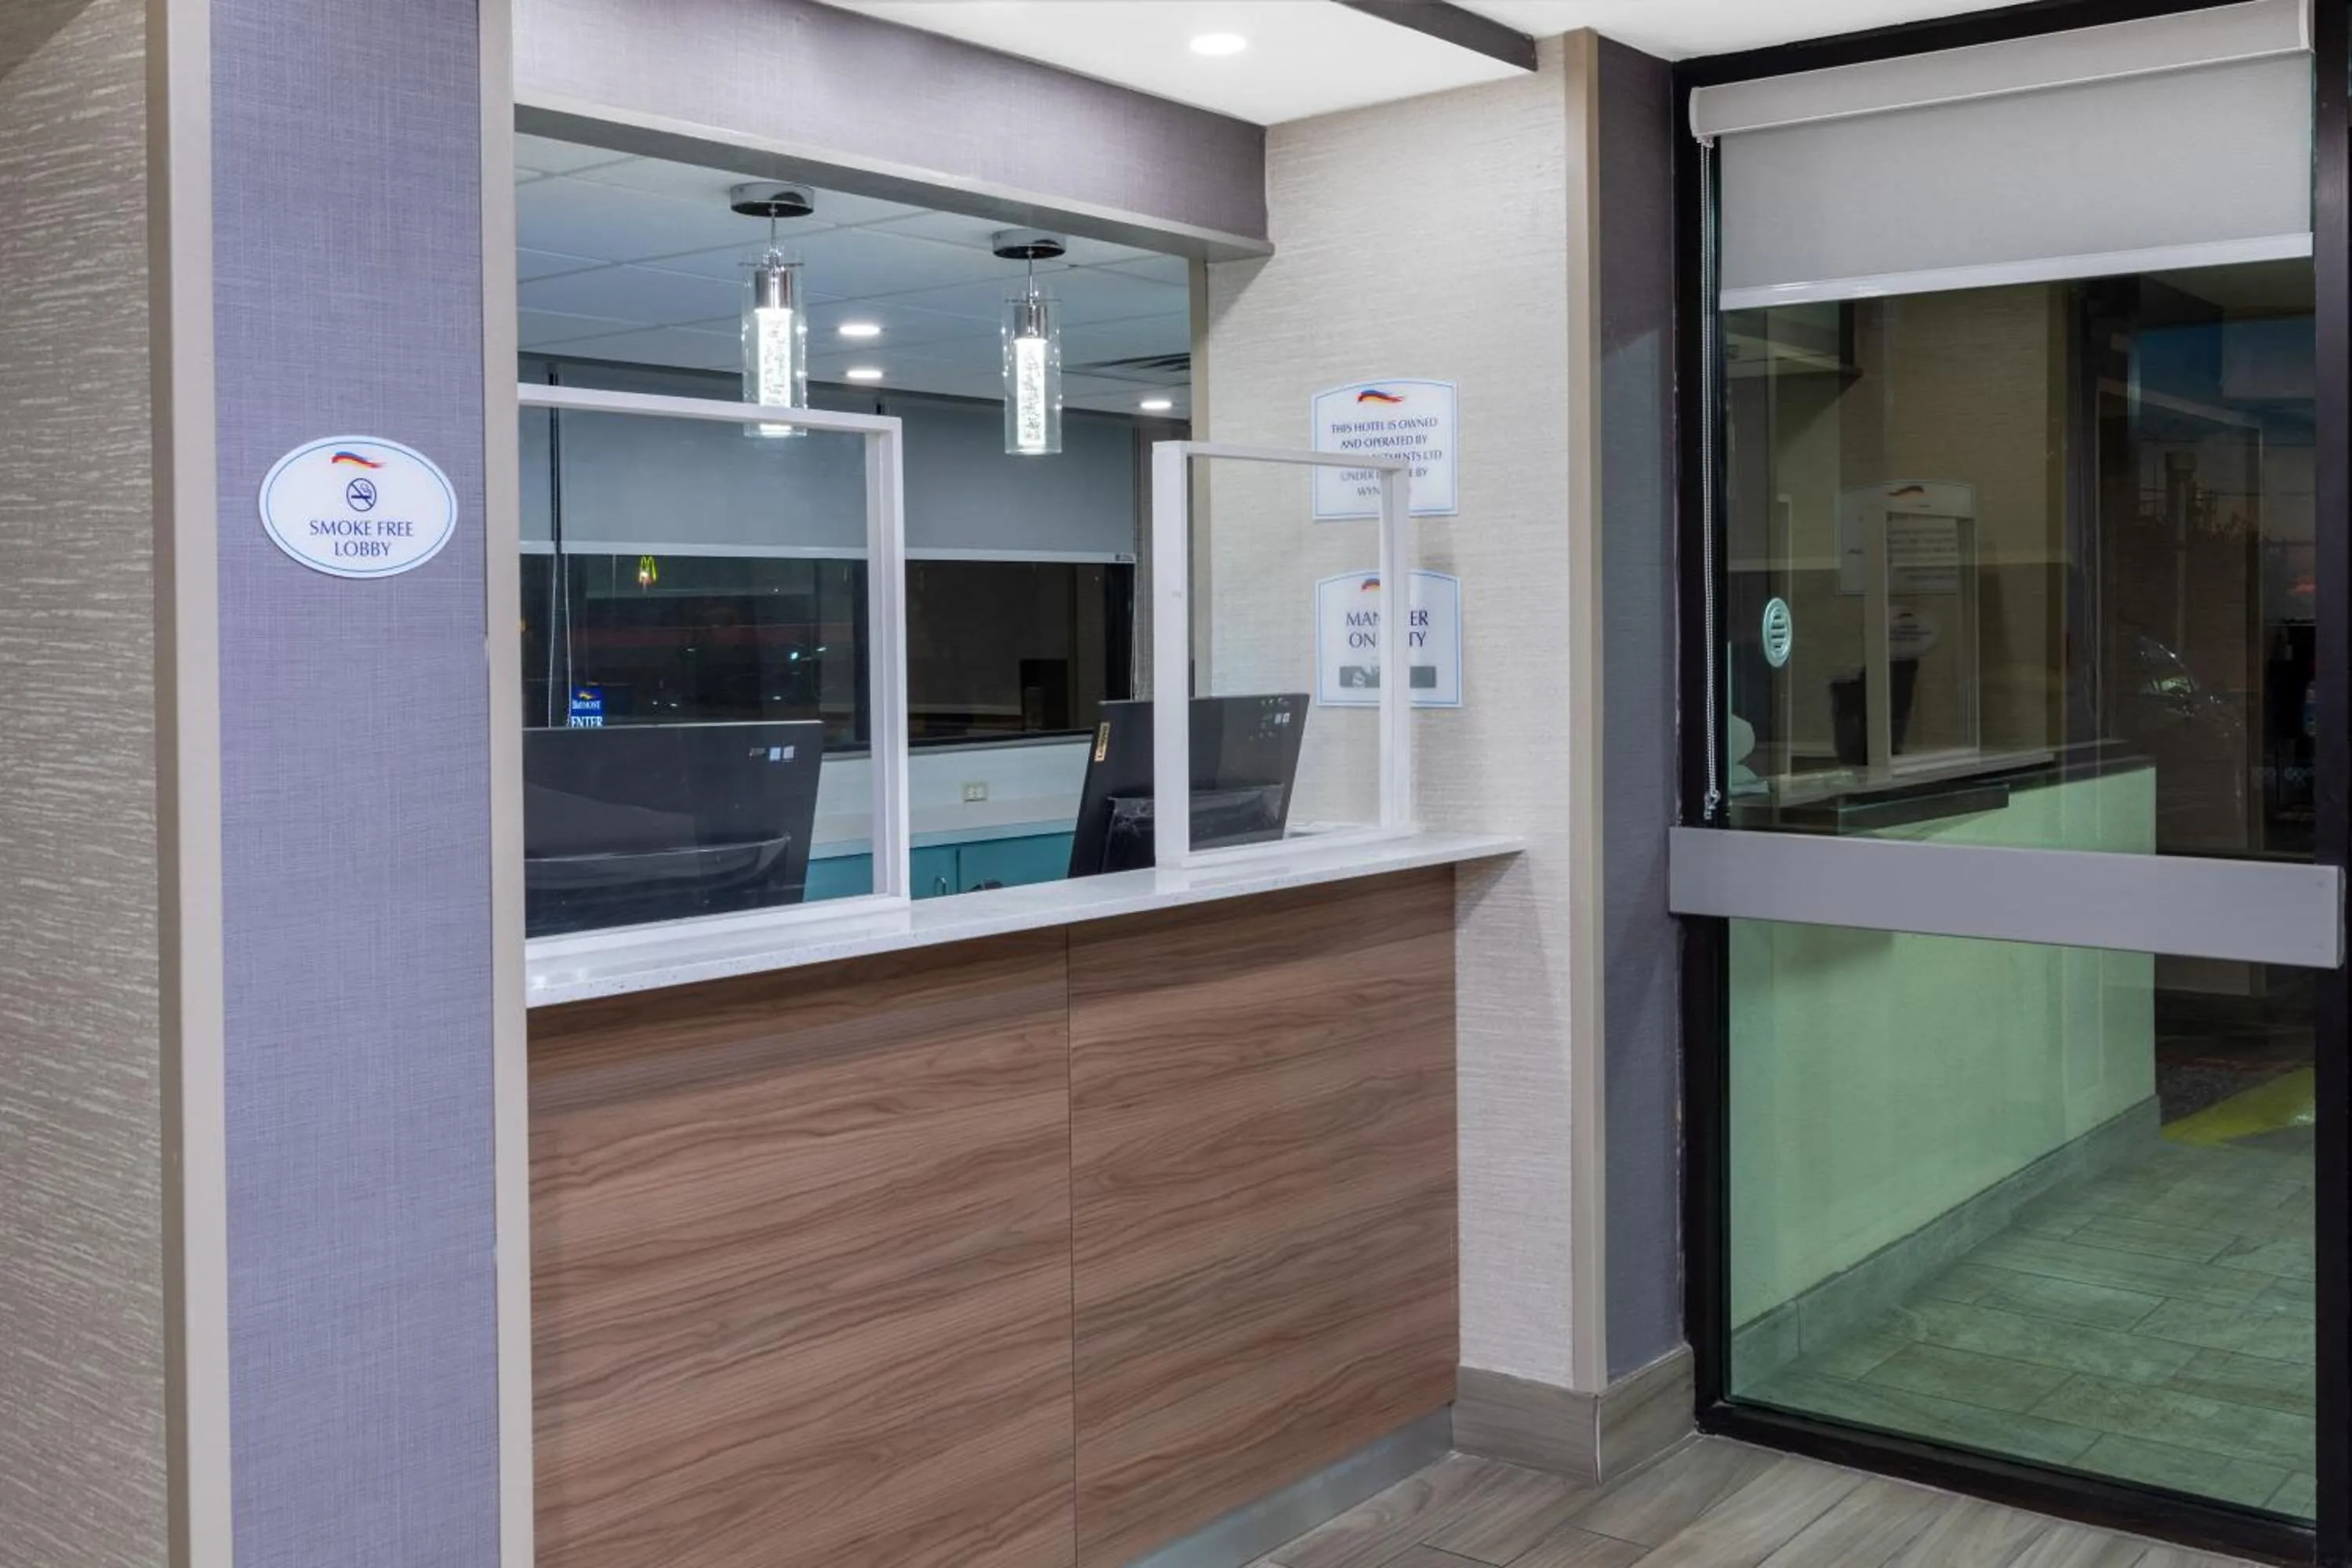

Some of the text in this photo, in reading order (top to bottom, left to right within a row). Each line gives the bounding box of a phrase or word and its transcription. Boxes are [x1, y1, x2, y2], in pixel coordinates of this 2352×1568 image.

[1330, 417, 1438, 434] THIS HOTEL IS OWNED
[1341, 434, 1428, 449] AND OPERATED BY
[1341, 470, 1374, 481] UNDER
[310, 520, 414, 536] SMOKE FREE
[335, 541, 392, 557] LOBBY
[1346, 609, 1429, 627] MANER
[1348, 631, 1377, 649] ON
[571, 716, 603, 728] ENTER
